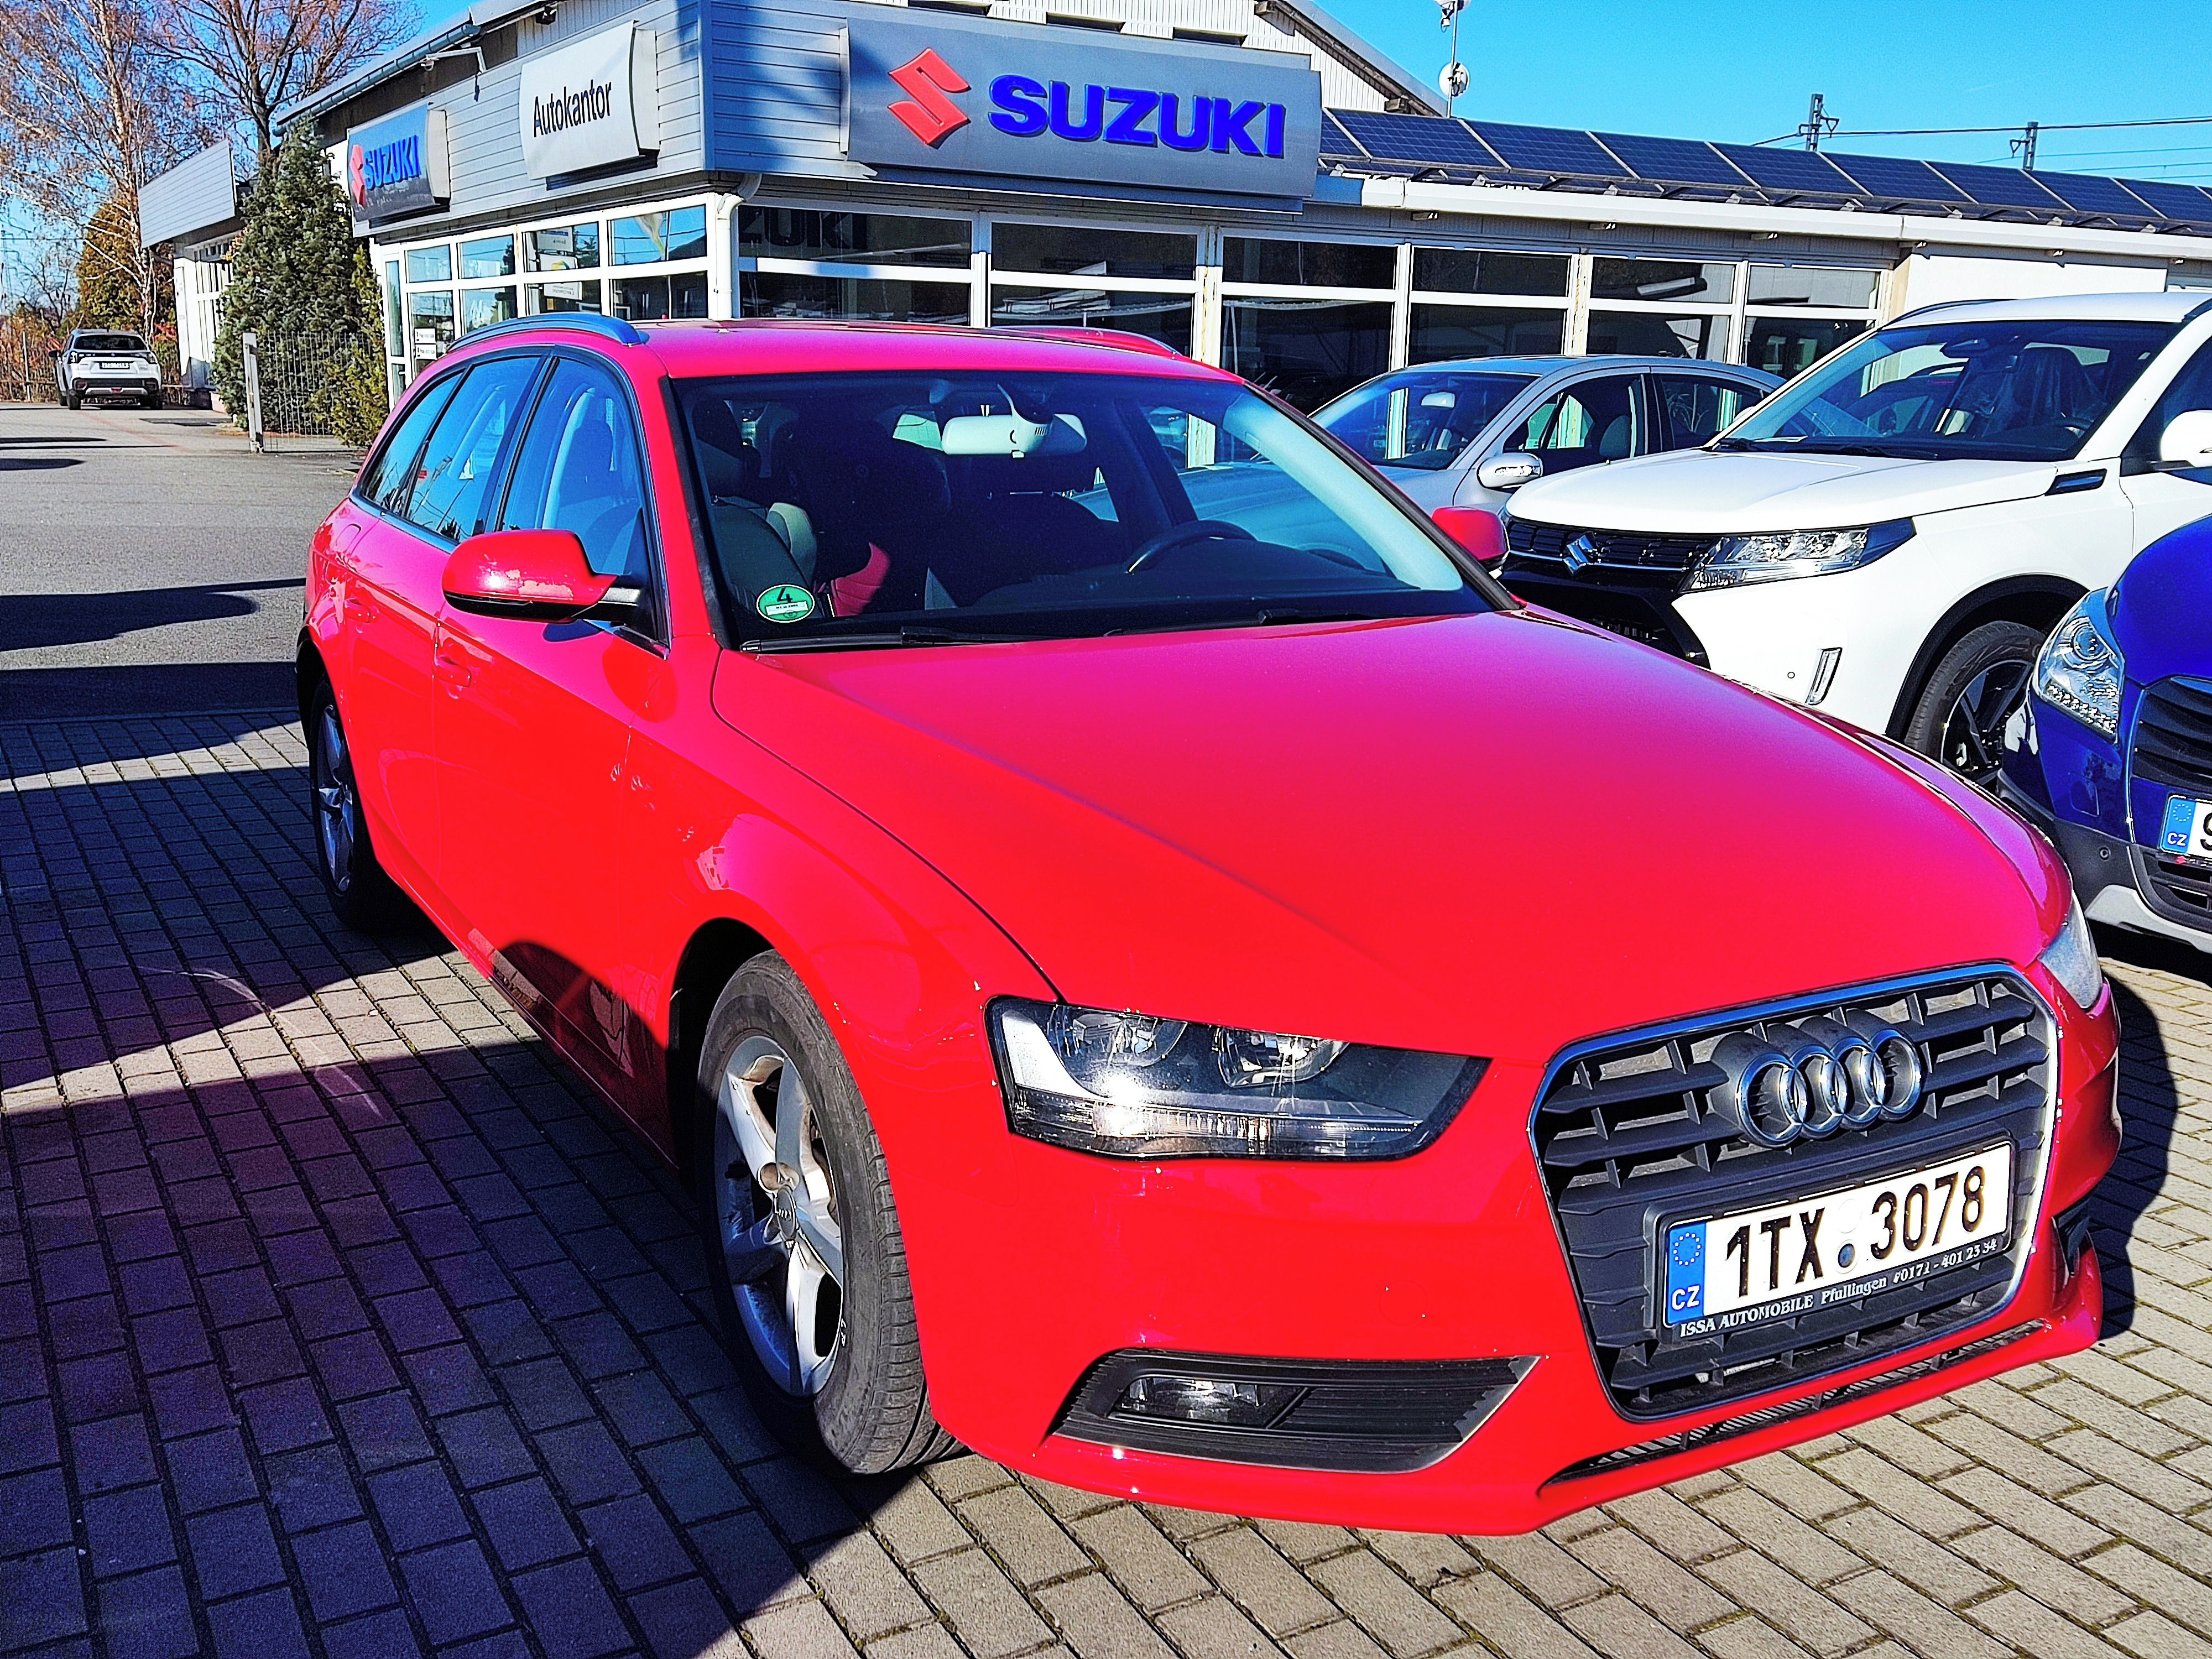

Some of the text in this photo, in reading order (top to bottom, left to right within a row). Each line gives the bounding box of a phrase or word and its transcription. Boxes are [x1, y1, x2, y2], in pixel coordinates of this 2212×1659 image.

[534, 79, 612, 138] Autokantor
[988, 74, 1286, 159] SUZUKI
[363, 135, 422, 191] SUZUKI
[776, 586, 793, 603] 4
[2167, 832, 2187, 847] CZ
[1725, 1165, 1986, 1298] 1TX 3078
[1671, 1285, 1700, 1311] CZ
[1680, 1316, 1717, 1338] ISSA
[1718, 1293, 1814, 1330] AUTOMOBILE
[1820, 1276, 1887, 1305] Pfullingen
[1965, 1244, 1981, 1261] 23
